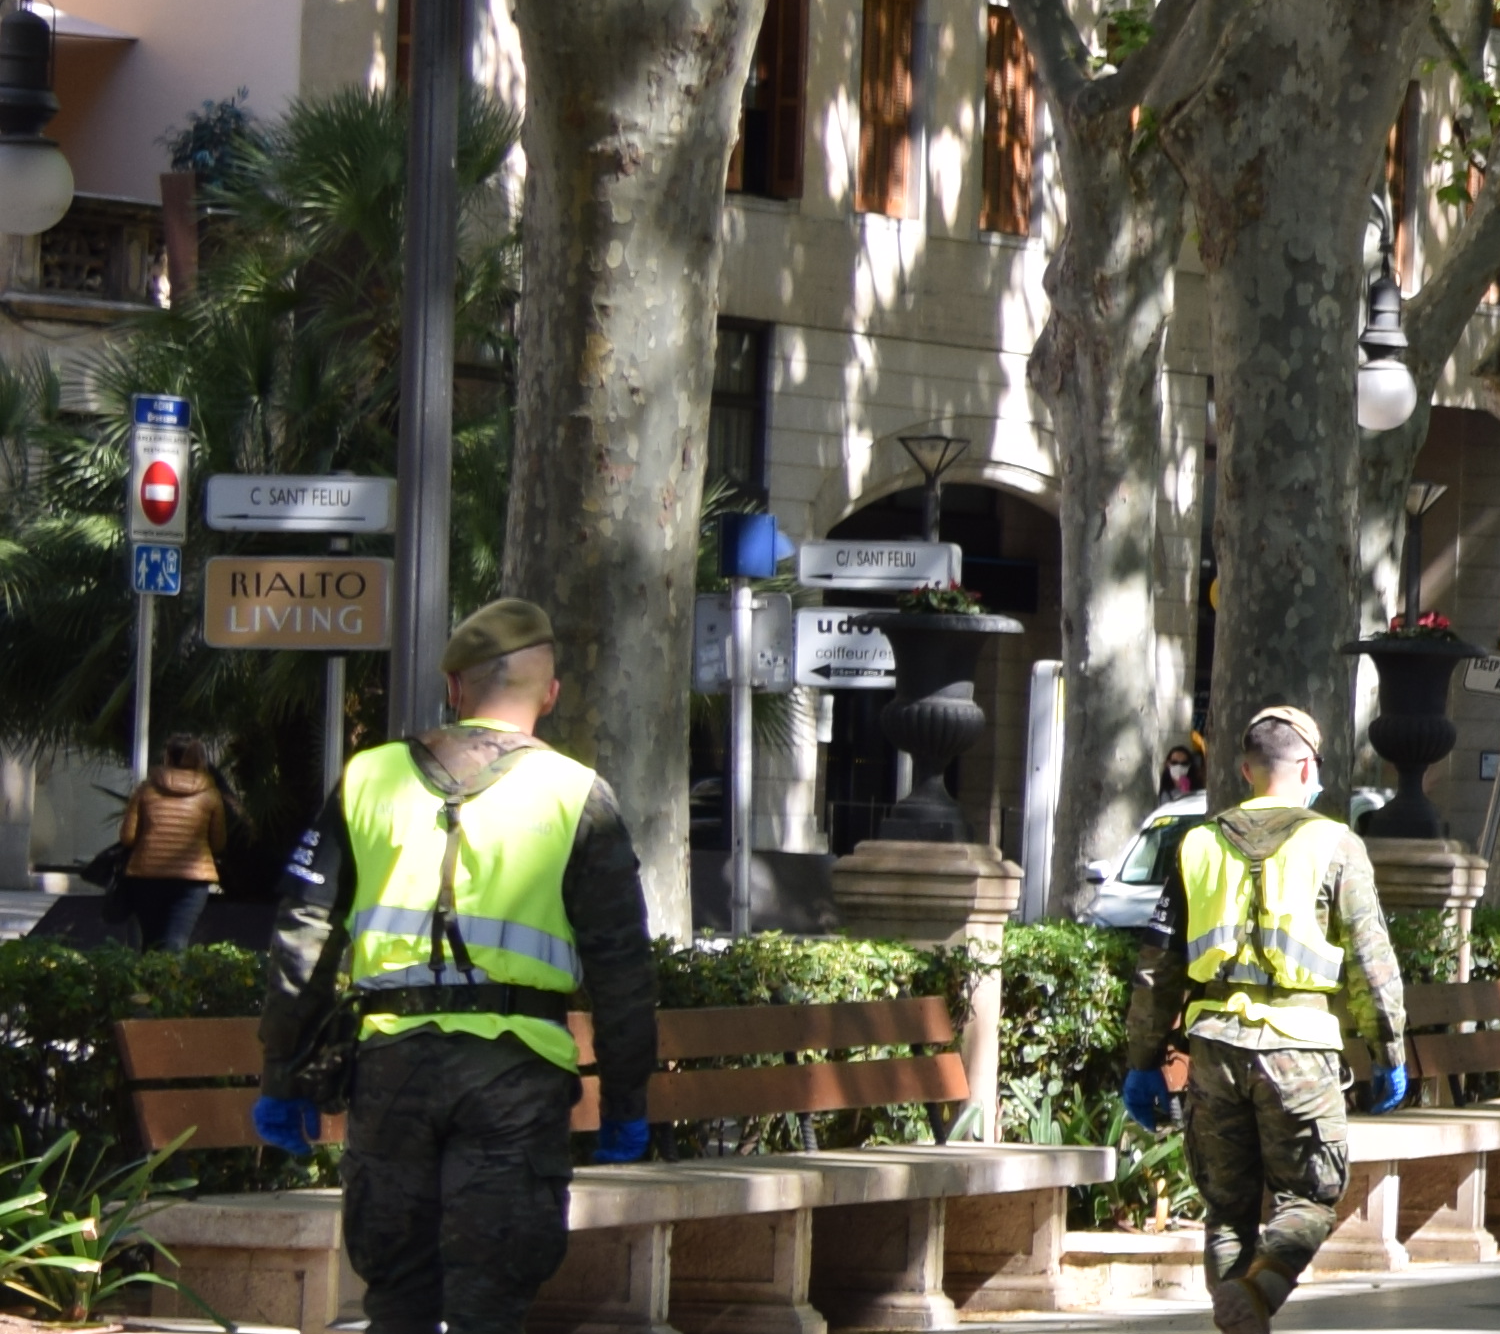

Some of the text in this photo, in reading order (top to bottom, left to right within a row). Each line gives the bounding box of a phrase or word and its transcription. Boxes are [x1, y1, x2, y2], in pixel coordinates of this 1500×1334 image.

[250, 487, 351, 506] C SANT FELIU
[857, 550, 884, 567] SANT
[888, 551, 916, 568] FELIU
[231, 572, 366, 600] RIALTO
[229, 605, 362, 635] LIVING
[815, 645, 868, 661] coiffeur
